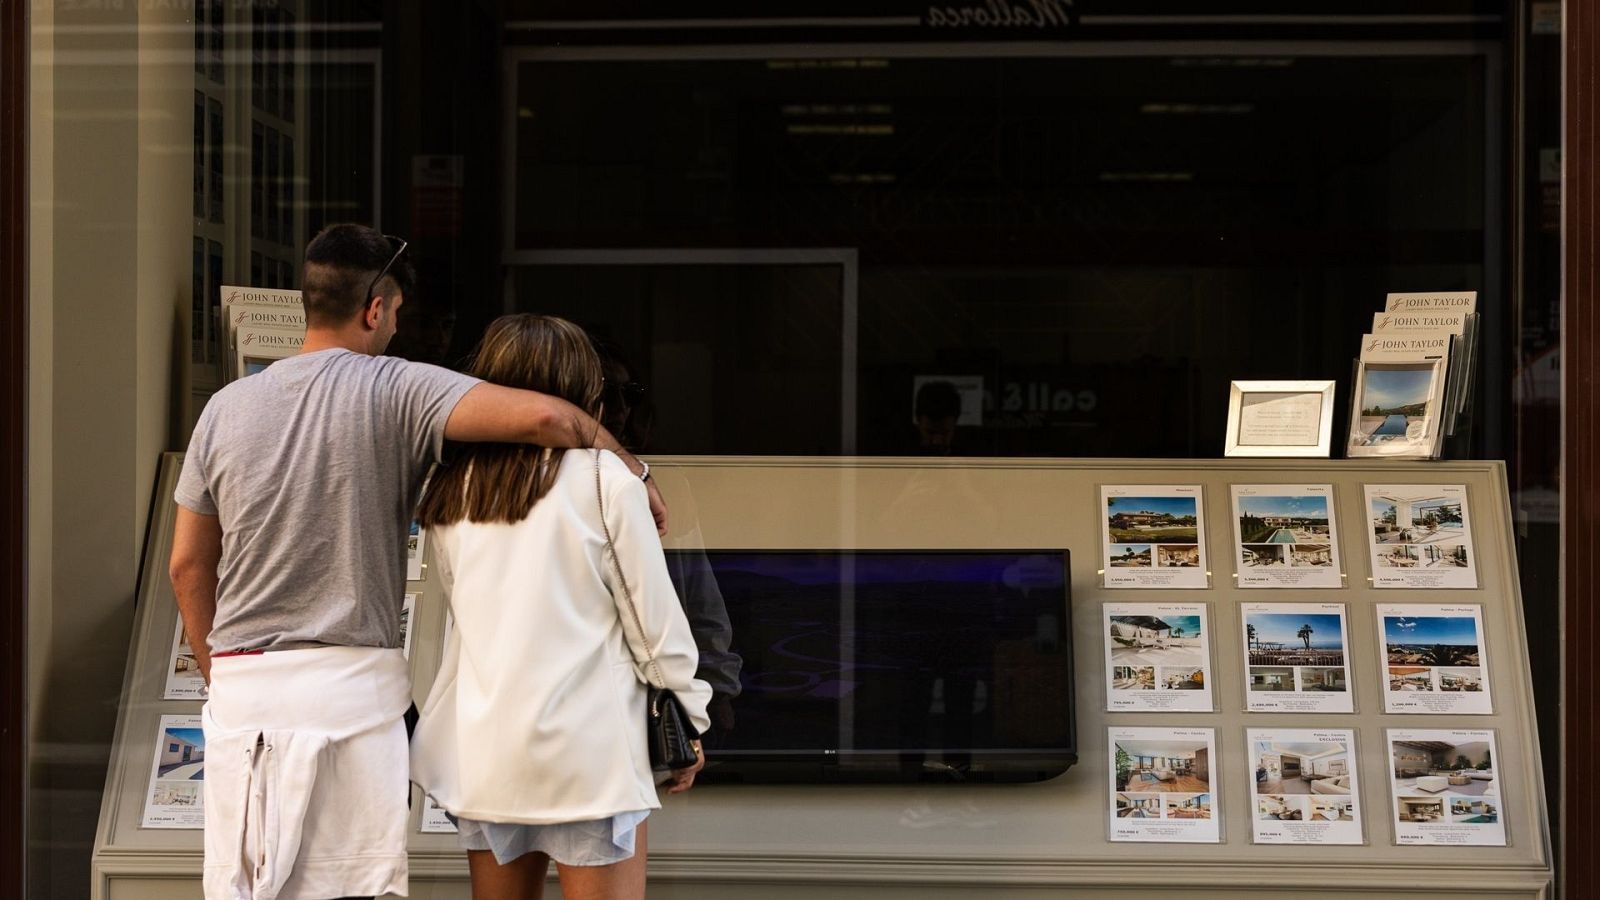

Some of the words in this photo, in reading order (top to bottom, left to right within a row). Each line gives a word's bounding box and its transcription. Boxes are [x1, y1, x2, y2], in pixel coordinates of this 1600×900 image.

[242, 293, 270, 302] JOHN
[272, 295, 304, 304] TAYLO
[1405, 299, 1431, 307] JOHN
[1433, 298, 1470, 306] TAYLOR
[251, 313, 277, 322] JOHN
[280, 315, 307, 324] TAYL
[1394, 318, 1420, 326] JOHN
[1422, 317, 1459, 326] TAYLOR
[258, 335, 284, 345] JOHN
[287, 337, 306, 346] TAY
[1382, 340, 1408, 349] JOHN
[1410, 339, 1445, 349] TAYLOR
